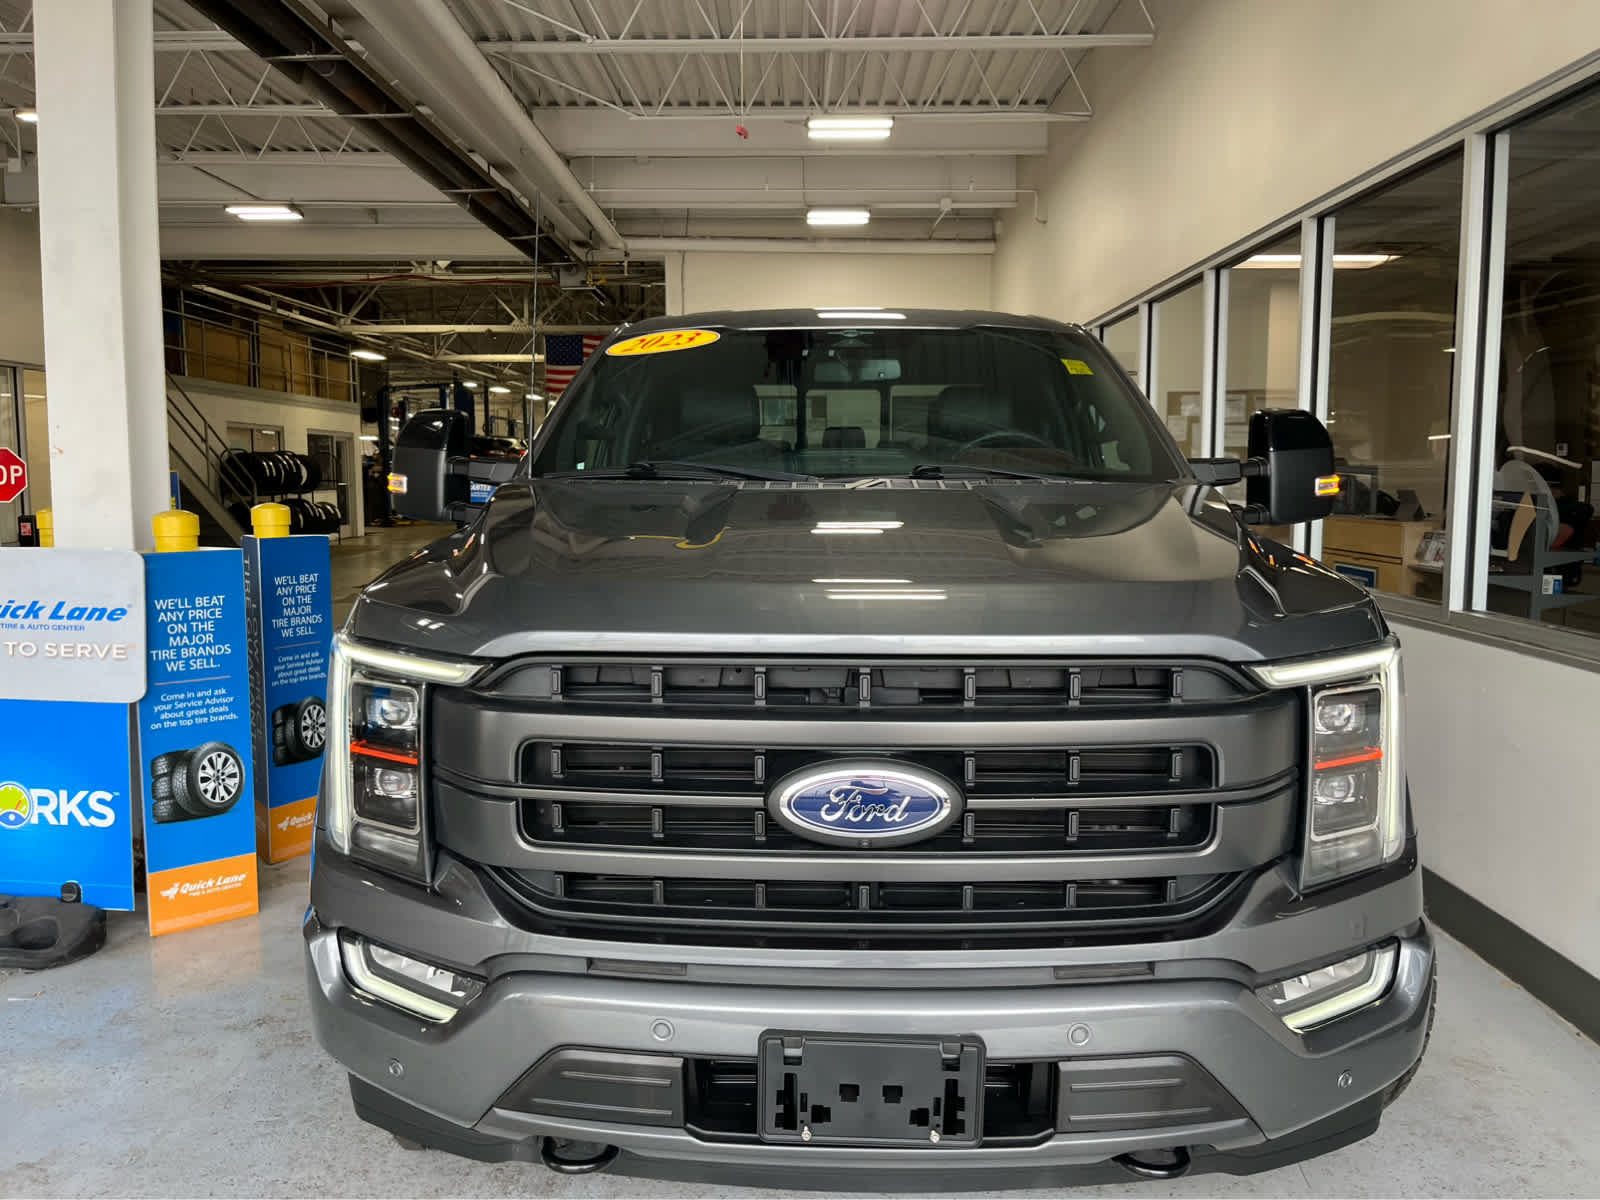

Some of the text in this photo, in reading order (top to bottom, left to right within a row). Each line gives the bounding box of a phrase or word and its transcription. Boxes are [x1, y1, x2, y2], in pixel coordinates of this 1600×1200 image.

[621, 331, 702, 351] 2023
[274, 573, 319, 585] WE'LL BEAT
[276, 584, 317, 596] ANY PRICE
[154, 595, 225, 610] WE'LL BEAT
[282, 595, 312, 606] ON THE
[0, 600, 46, 619] ick
[158, 608, 223, 622] ANY PRICE
[283, 606, 312, 617] MAJOR
[51, 624, 86, 632] CENTER
[167, 620, 215, 634] ON THE
[271, 614, 323, 629] TIRE BRANDS
[169, 633, 214, 647] MAJOR
[281, 628, 294, 638] WE
[3, 641, 128, 660] TO SERVE
[150, 644, 232, 661] TIRE BRANDS
[165, 657, 221, 673] WE SELL.
[160, 692, 185, 702] Come
[196, 689, 212, 697] and
[213, 688, 227, 696] ask
[153, 696, 235, 713] your Service Advisor
[160, 705, 229, 720] about great deals
[150, 722, 162, 730] on
[163, 720, 178, 728] the
[179, 718, 194, 727] top
[194, 716, 209, 724] tire
[820, 785, 912, 822] Ford
[180, 878, 215, 894] Quick
[216, 873, 247, 886] Lane
